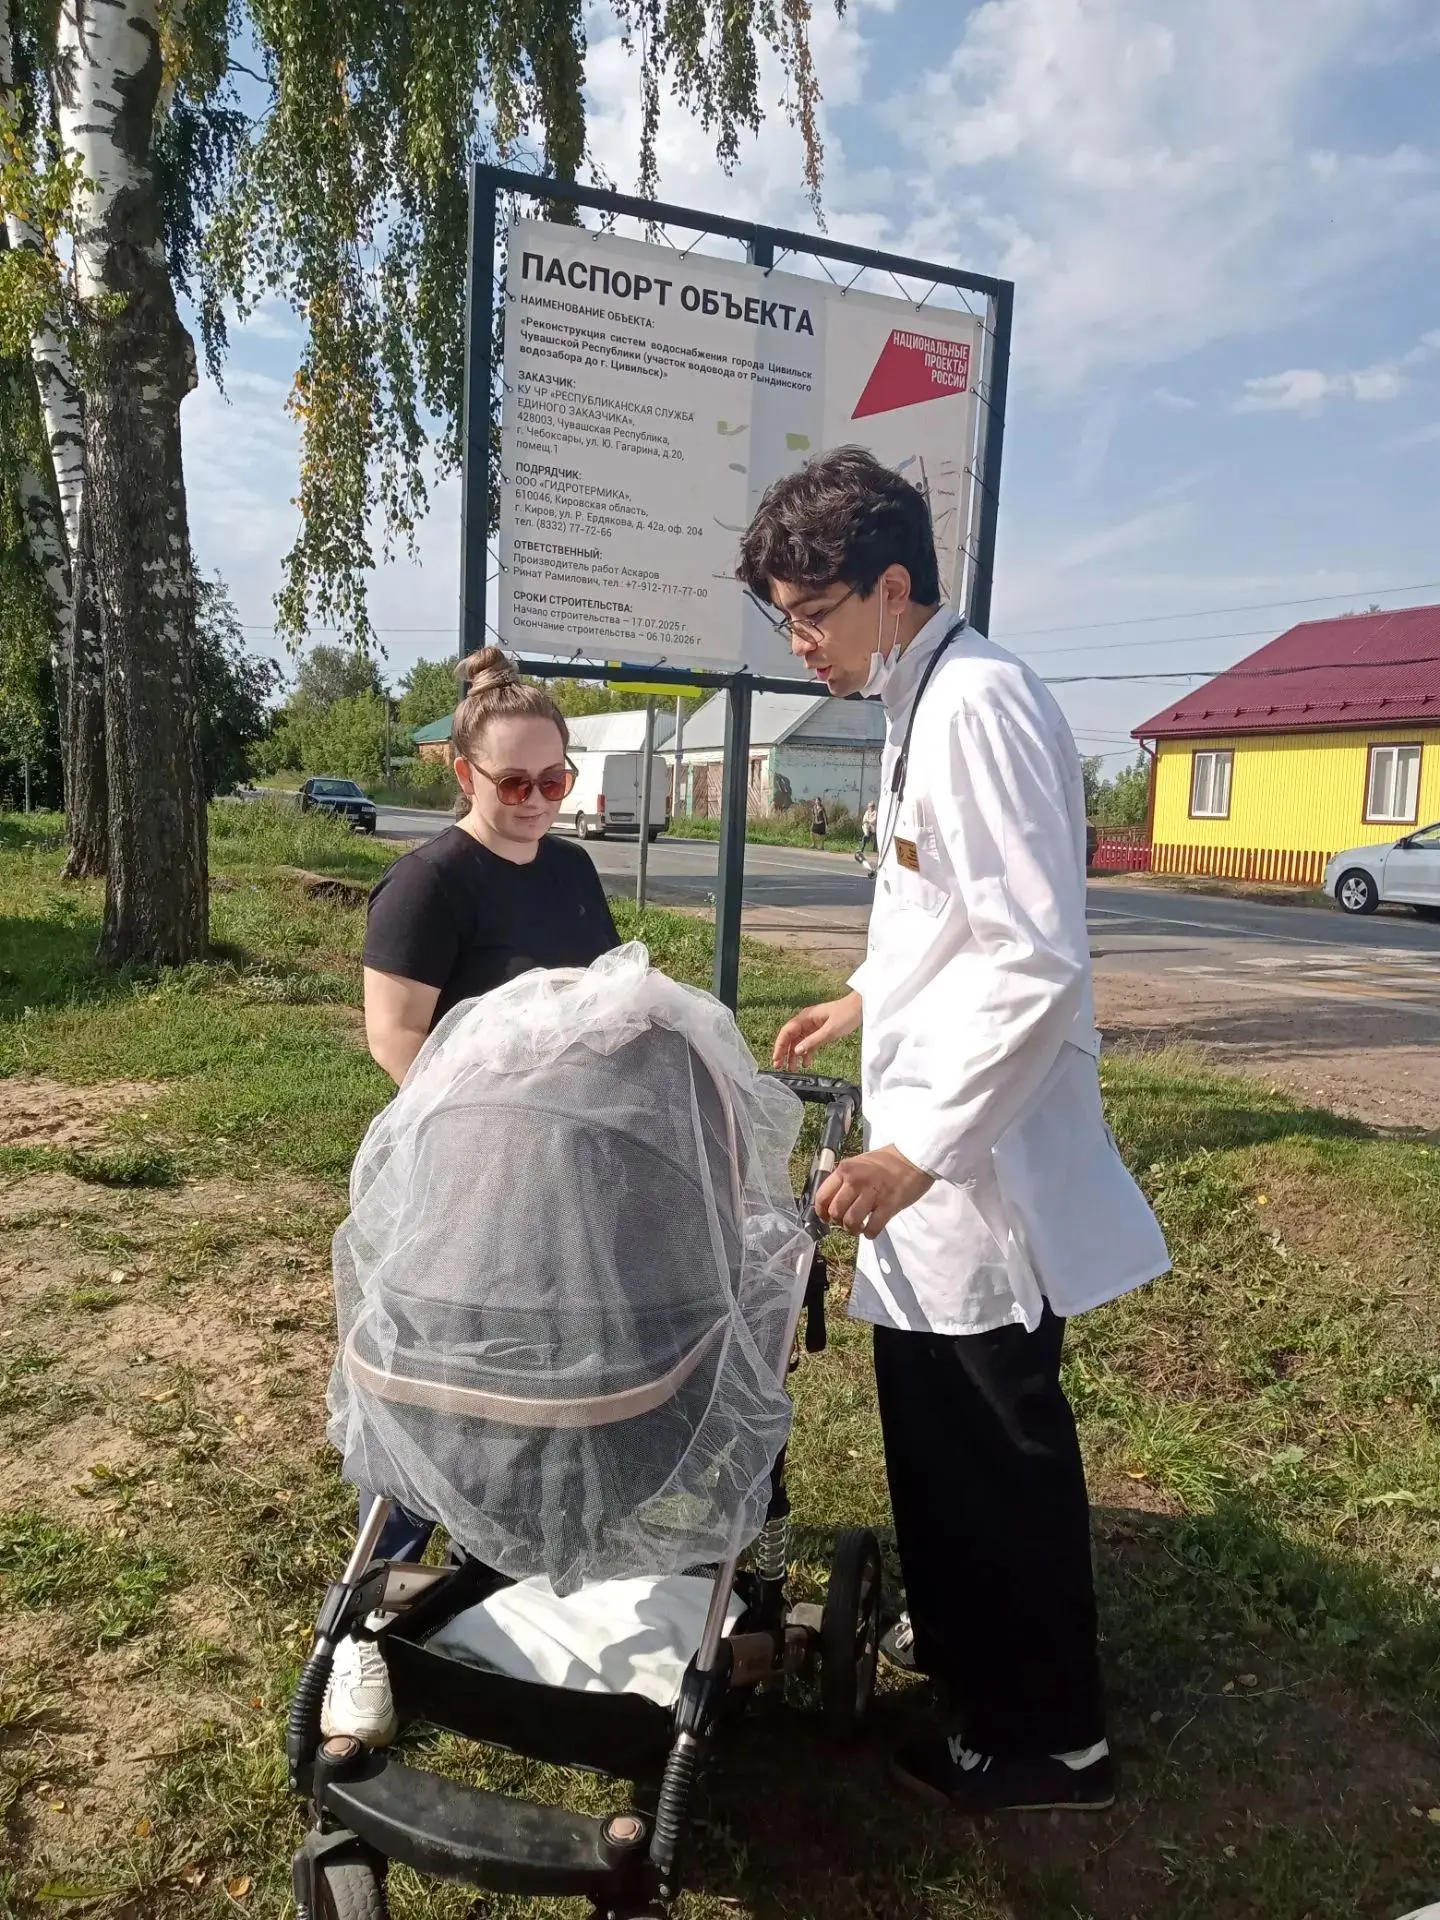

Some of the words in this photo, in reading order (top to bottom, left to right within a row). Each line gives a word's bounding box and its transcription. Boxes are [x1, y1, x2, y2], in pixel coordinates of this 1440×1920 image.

[522, 252, 673, 306] ПАСПОРТ
[681, 285, 814, 336] ОБЪЕКТА
[521, 294, 606, 319] НАИМЕНОВАНИЕ
[608, 311, 655, 329] ОБЪЕКТА:
[521, 317, 606, 340] «Реконструкция
[610, 335, 646, 348] систем
[651, 342, 728, 363] водоснабжения
[732, 358, 765, 371] города
[769, 362, 812, 379] Цивильск
[893, 331, 968, 360] НАЦИОНАЛЬНЫЕ
[520, 330, 579, 349] Чувашской
[582, 341, 641, 360] Республики
[644, 352, 686, 369] (участок
[688, 363, 735, 379] водовода
[737, 371, 748, 380] от
[751, 372, 812, 392] Рындинского
[520, 345, 583, 364] водозабора
[585, 357, 598, 367] до
[611, 360, 668, 378] Цивильск)»
[924, 353, 967, 374] ПРОЕКТЫ
[518, 370, 576, 389] ЗАКАЗЧИК:
[931, 369, 966, 388] РОССИИ
[518, 384, 531, 394] КУ
[534, 387, 548, 397] ЧР
[551, 390, 653, 415] «РЕСПУБЛИКАНСКАЯ
[655, 408, 694, 422] СЛУЖБА
[518, 398, 566, 414] ЕДИНОГО
[569, 406, 635, 427] ЗАКАЗЧИКА»,
[518, 412, 555, 427] 428003,
[558, 418, 611, 435] Чувашская
[614, 427, 670, 446] Республика,
[527, 426, 584, 445] Чебоксары,
[586, 438, 599, 448] ул.
[602, 438, 613, 449] Ю.
[616, 441, 661, 458] Гагарина,
[516, 462, 582, 480] ПОДРЯДЧИК:
[516, 476, 537, 487] ООО
[540, 480, 632, 502] «ГИДРОТЕРМИКА»,
[516, 489, 552, 504] 610046,
[555, 495, 607, 511] Кировская
[609, 503, 649, 518] область,
[525, 504, 557, 518] Киров,
[559, 511, 572, 520] ул.
[587, 512, 634, 528] Ердякова,
[636, 521, 645, 531] д.
[648, 521, 666, 533] 42а,
[668, 524, 684, 535] оф.
[687, 526, 703, 536] 204
[537, 518, 567, 534] (8332)
[570, 523, 612, 537] 77-72-66
[514, 540, 603, 560] ОТВЕТСТВЕННЫЙ:
[514, 553, 589, 571] Производитель
[592, 564, 619, 575] работ
[621, 567, 660, 580] Аскаров
[514, 567, 542, 578] Ринат
[545, 571, 600, 586] Рамилович,
[626, 580, 708, 598] +7-912-717-77-00
[514, 591, 547, 603] СРОКИ
[549, 595, 633, 613] СТРОИТЕЛЬСТВА:
[514, 604, 548, 617] Начало
[551, 610, 621, 624] строительства
[632, 617, 680, 631] 17.07.2025
[514, 617, 565, 632] Окончание
[567, 624, 636, 639] строительства
[647, 632, 695, 645] 06.10.2026
